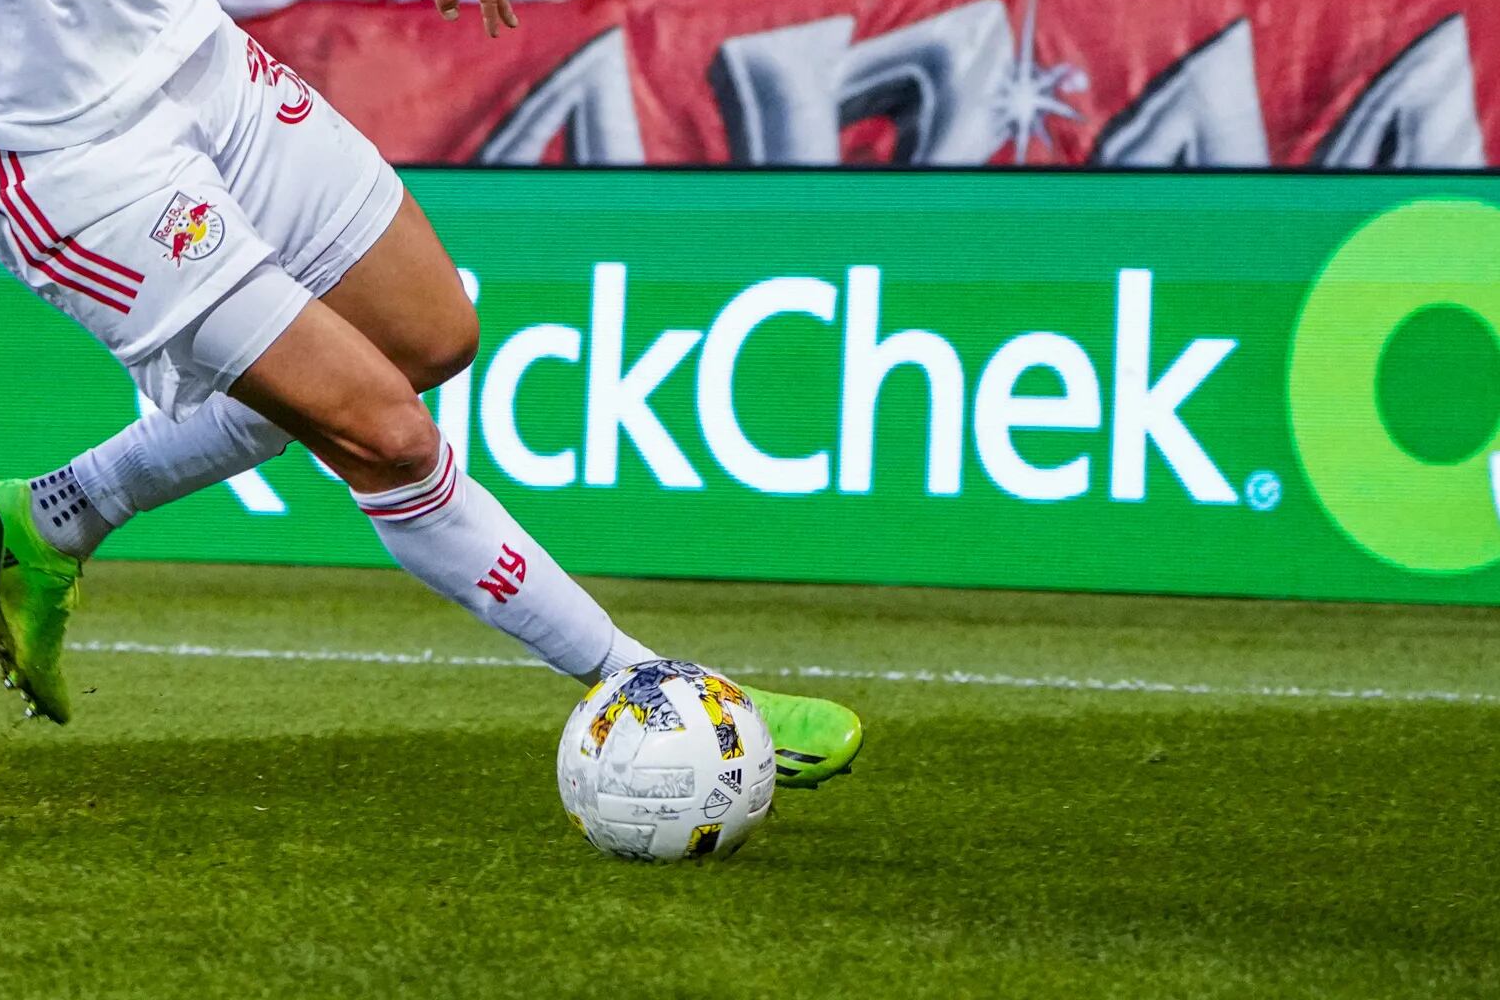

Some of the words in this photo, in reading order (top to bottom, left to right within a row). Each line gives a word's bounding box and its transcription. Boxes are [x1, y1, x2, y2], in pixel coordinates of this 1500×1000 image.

[225, 260, 1239, 513] ickChek
[475, 542, 527, 605] NY
[712, 790, 726, 803] MLS
[717, 772, 743, 796] adidas
